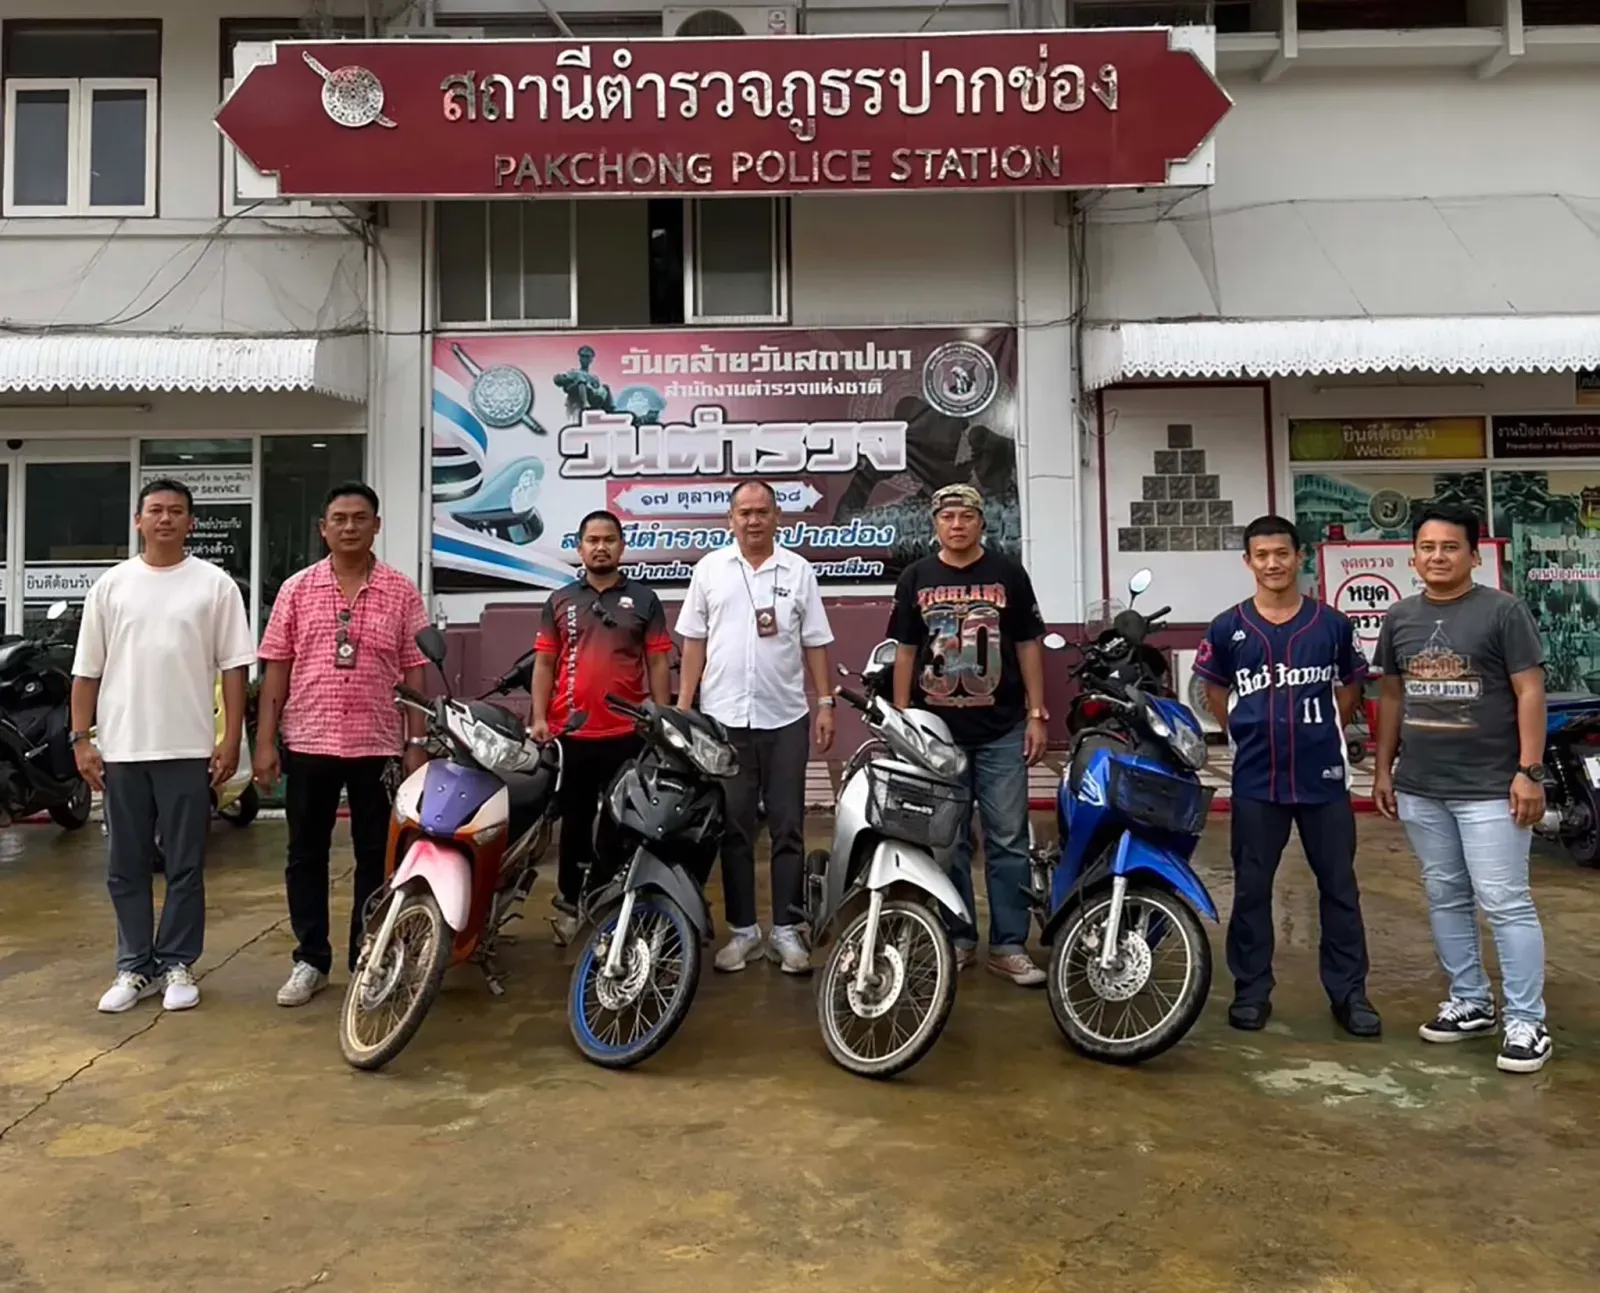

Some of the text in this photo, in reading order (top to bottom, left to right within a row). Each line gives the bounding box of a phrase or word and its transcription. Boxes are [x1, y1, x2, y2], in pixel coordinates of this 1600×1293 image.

[440, 44, 1119, 141] สถานีตำรวจภูธรปากช่อง
[494, 145, 1062, 187] PAKCHONG POLICE STATION
[620, 343, 912, 374] วันคล้ายวันสถาปนา
[663, 378, 883, 400] สำนักงานตำรวจแห่งชาติ
[559, 404, 909, 478] วันตำรวจ
[1353, 443, 1427, 458] Welcome
[1347, 584, 1389, 608] หยุด
[919, 607, 1002, 697] 30
[1302, 698, 1323, 724] 11
